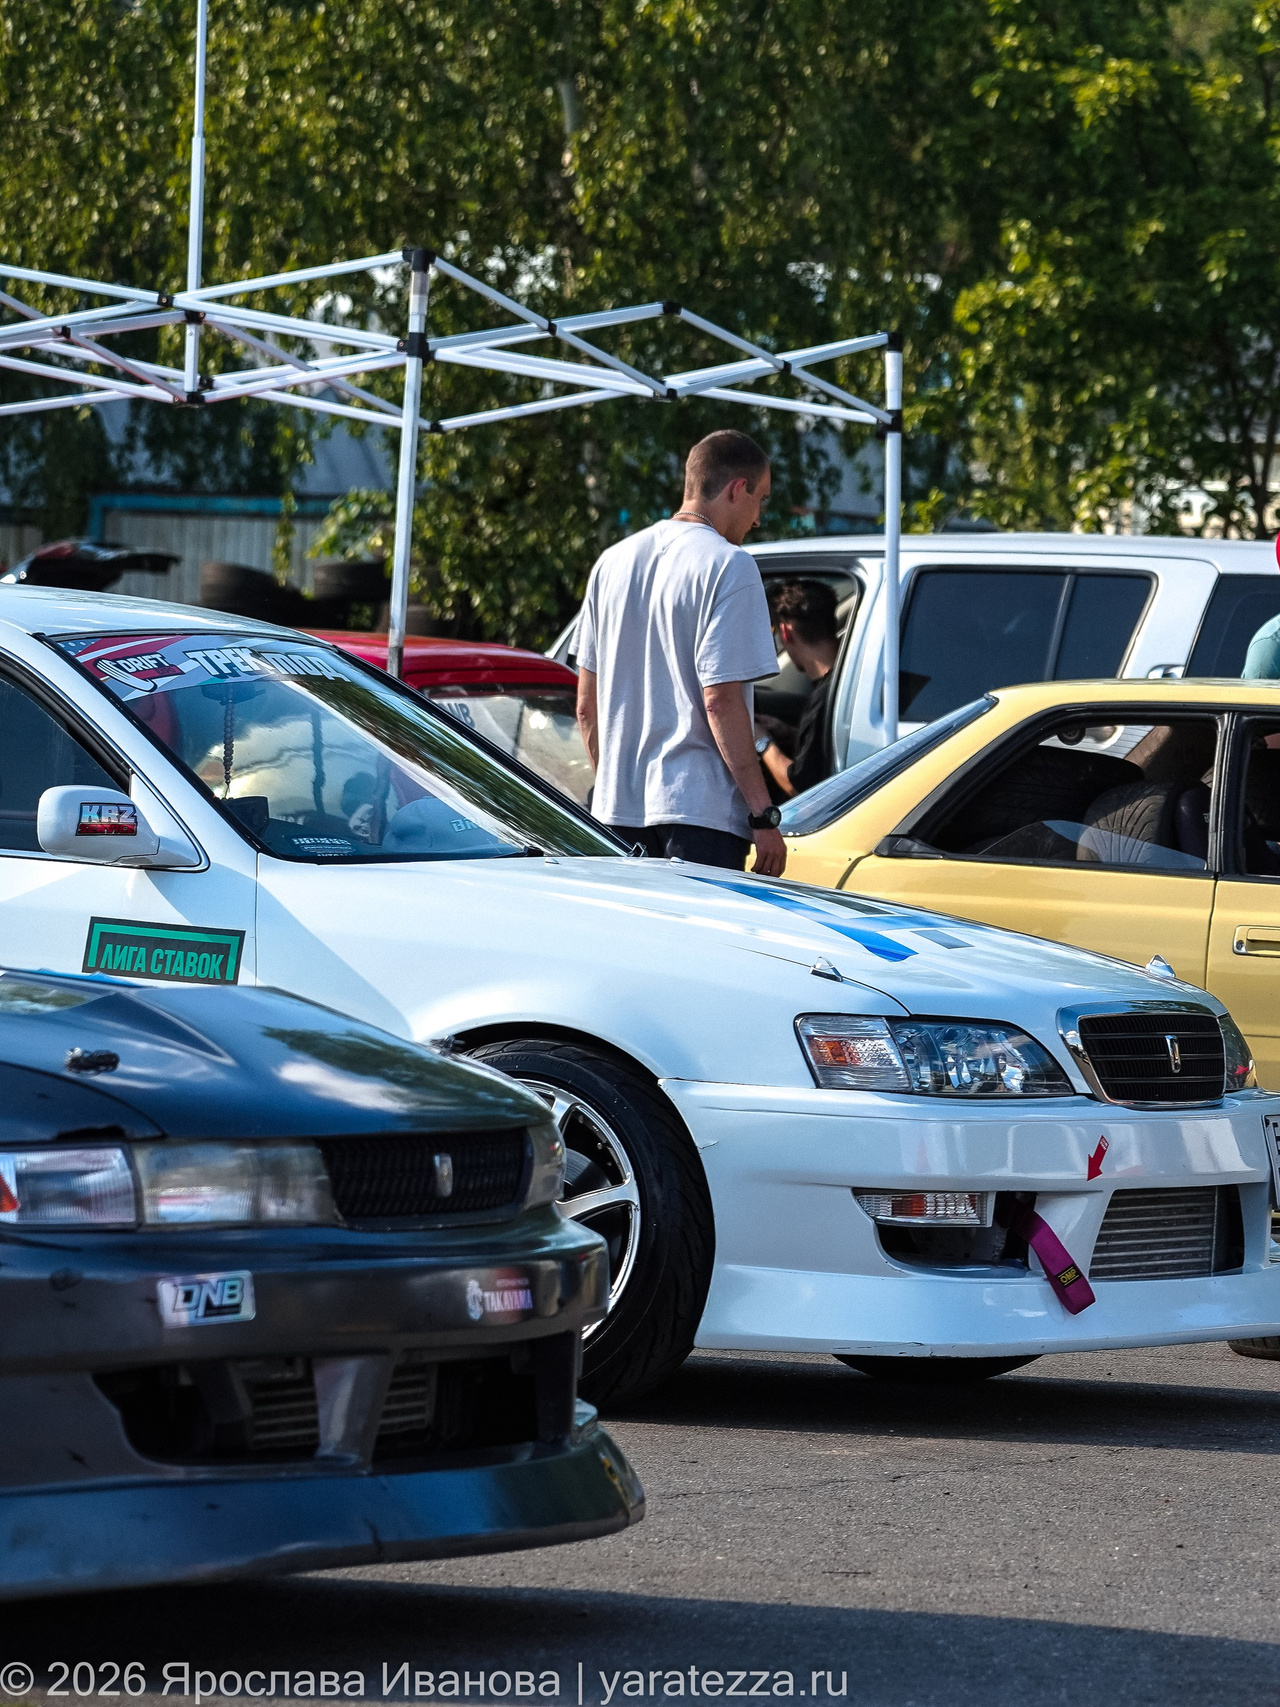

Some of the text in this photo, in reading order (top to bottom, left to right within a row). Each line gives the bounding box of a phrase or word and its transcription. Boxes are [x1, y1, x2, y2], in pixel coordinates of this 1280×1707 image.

[115, 653, 168, 674] DRIFT
[185, 648, 275, 677] ТРЕК
[80, 804, 136, 823] KRZ
[100, 943, 225, 980] ЛИГА СТАВОК
[1060, 1268, 1077, 1284] OMP
[173, 1278, 244, 1318] DNB
